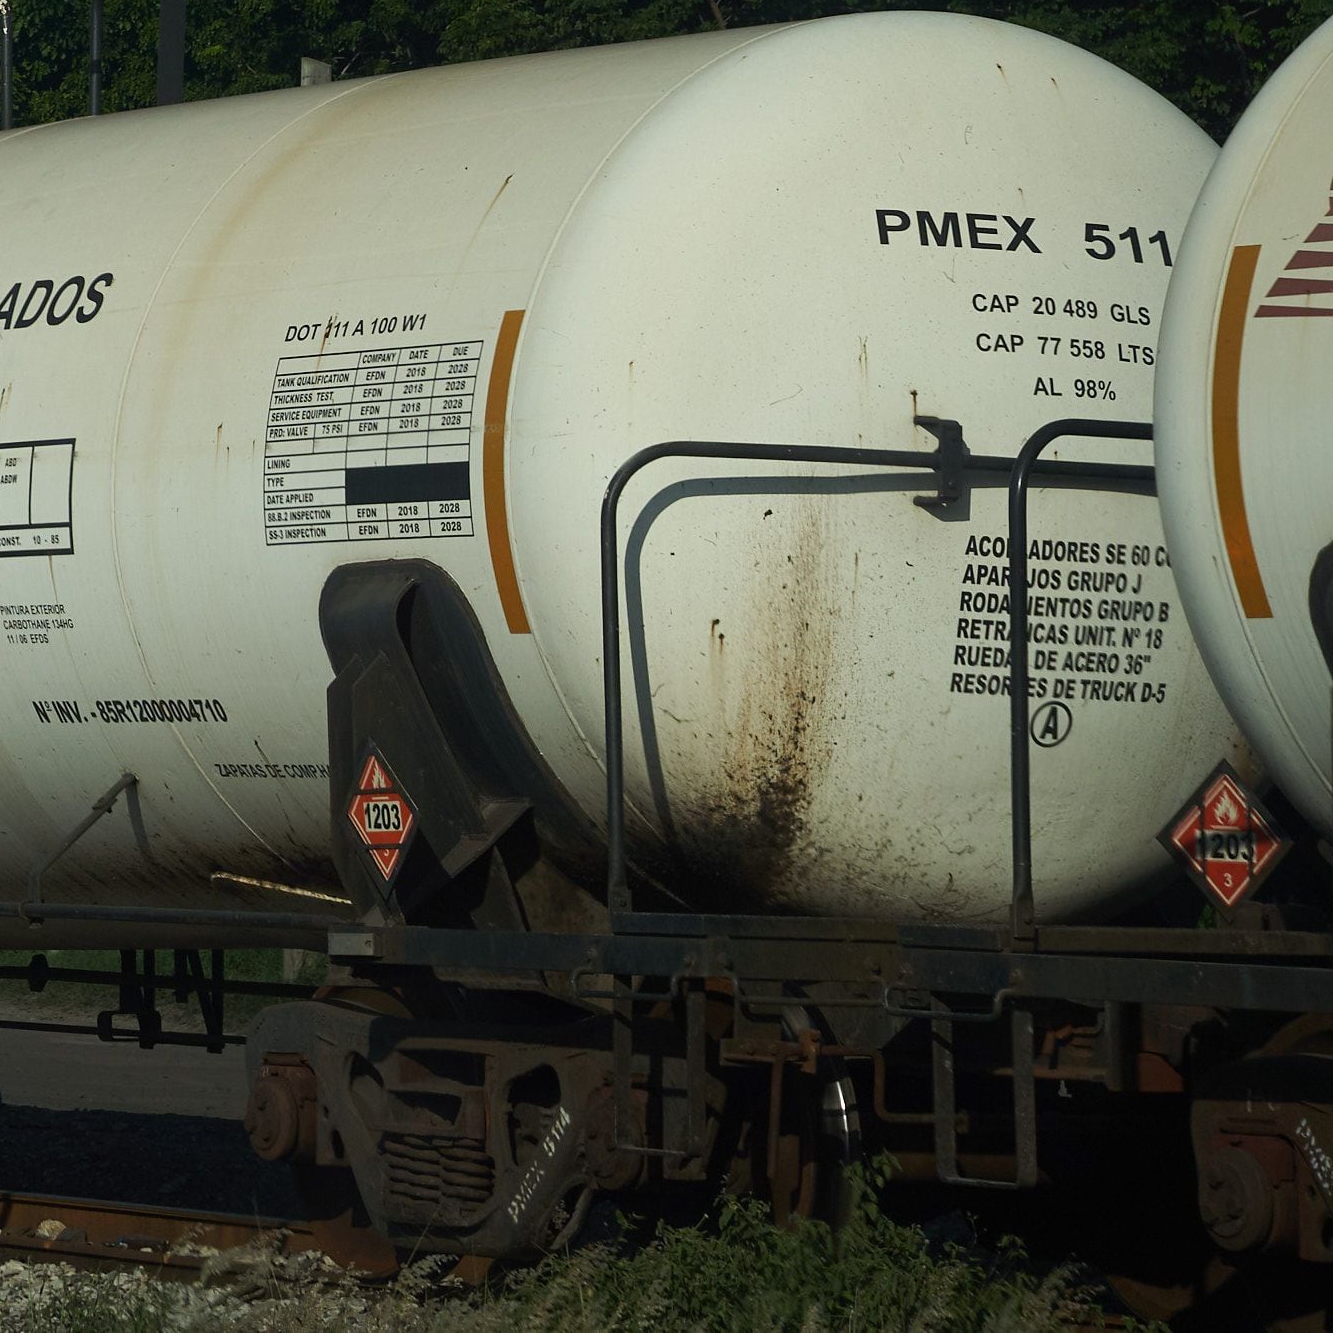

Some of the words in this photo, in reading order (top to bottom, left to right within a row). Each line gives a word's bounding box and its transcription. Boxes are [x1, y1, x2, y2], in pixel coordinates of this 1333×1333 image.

[875, 209, 1043, 254] PMEX
[972, 293, 1019, 313] CAP
[1032, 297, 1056, 316] 20
[1063, 299, 1098, 319] 489
[1110, 303, 1151, 326] GLS
[284, 323, 322, 342] DOT
[351, 319, 364, 337] A
[371, 317, 398, 335] 100
[402, 314, 427, 332] W1
[362, 352, 397, 364] COMPANY
[409, 349, 429, 360] DATE
[452, 346, 469, 357] DUE
[976, 333, 1024, 353] CAP
[1037, 336, 1062, 356] 77
[1070, 339, 1106, 360] 558
[1118, 343, 1155, 366] LTS
[277, 377, 296, 388] TANK
[296, 373, 350, 386] QUALIFICATION
[366, 370, 386, 381] EFDN
[406, 366, 427, 378] 2018
[447, 363, 469, 374] 2028
[274, 393, 313, 405] THICKNESS
[316, 391, 334, 402] TEST
[363, 388, 383, 398] EFDN
[403, 383, 424, 395] 2018
[445, 380, 466, 391] 2028
[1033, 377, 1063, 397] AL
[1074, 379, 1117, 401] 98%
[271, 410, 300, 422] SERVICE
[301, 408, 342, 420] EQUIPMENT
[360, 405, 380, 416] EFDN
[400, 402, 421, 413] 2018
[442, 398, 463, 410] 2028
[287, 426, 309, 437] VALVE
[322, 424, 330, 435] 75
[332, 424, 343, 434] PSI
[358, 422, 378, 432] EFDN
[399, 418, 419, 429] 2018
[441, 415, 462, 426] 2028
[267, 458, 291, 470] LINING
[267, 477, 285, 487] TYPE
[266, 494, 284, 505] DATE
[285, 493, 314, 504] APPLIED
[289, 509, 331, 522] INSPECTION
[356, 508, 378, 518] EFDN
[398, 505, 419, 516] 2018
[439, 502, 461, 514] 2028
[268, 529, 283, 540] SS-3
[285, 527, 327, 539] INSPECTION
[358, 525, 379, 536] EFDN
[399, 523, 420, 534] 2018
[441, 521, 462, 532] 2028
[965, 535, 1101, 564] ACOADORES
[1105, 543, 1127, 565] SE
[1132, 544, 1150, 567] 60
[962, 564, 1062, 591] APARJOS
[1067, 570, 1128, 594] GRUPO
[1132, 574, 1143, 595] J
[0, 604, 31, 616] PINTURA
[30, 604, 66, 615] EXTERIOR
[960, 591, 1093, 620] RODAIENTOS
[1097, 598, 1154, 622] GRUPO
[1158, 601, 1170, 623] B
[2, 619, 51, 630] CARBOTHANE
[1074, 625, 1117, 648] UNIT.
[1122, 627, 1141, 649] Nº
[1145, 628, 1164, 650] 18
[954, 645, 1013, 669] RUED
[1034, 649, 1058, 671] DE
[1062, 651, 1120, 674] ACERO
[950, 672, 1048, 698] RESORES
[1052, 678, 1076, 700] DE
[1080, 680, 1137, 703] TRUCK
[1141, 683, 1167, 704] D-5
[51, 700, 89, 724] INV.
[1039, 706, 1059, 740] A
[214, 763, 268, 778] ZAPATAS
[265, 764, 286, 778] DE
[365, 802, 401, 830] 1203
[1223, 872, 1233, 888] 3
